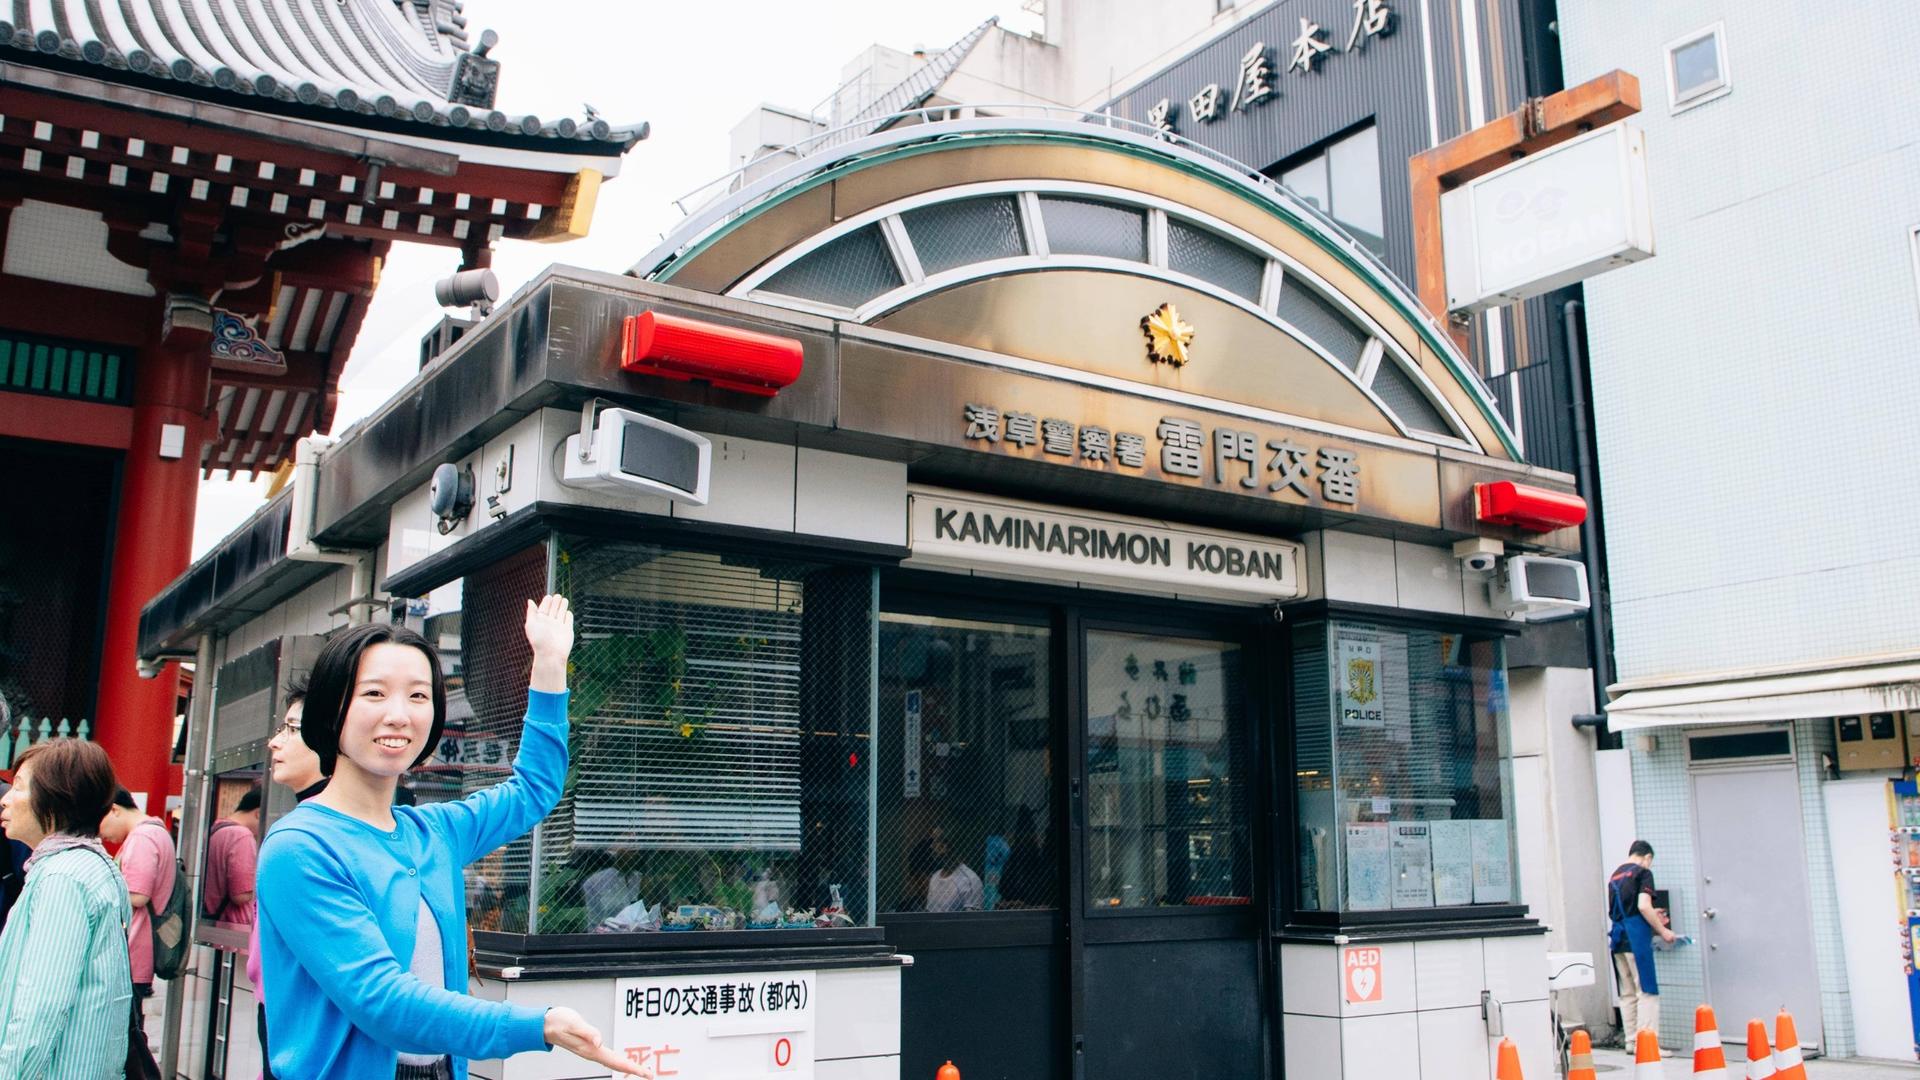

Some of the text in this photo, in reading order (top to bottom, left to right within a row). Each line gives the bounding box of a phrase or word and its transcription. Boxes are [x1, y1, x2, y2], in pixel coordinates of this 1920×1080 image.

[1147, 0, 1392, 143] 黒田屋本店
[963, 403, 1361, 506] 浅草警察署 雷門交番
[935, 506, 1283, 581] KAMINARIMON KOBAN
[1344, 708, 1382, 721] POLICE
[1347, 949, 1380, 968] AED
[774, 1037, 792, 1067] 0
